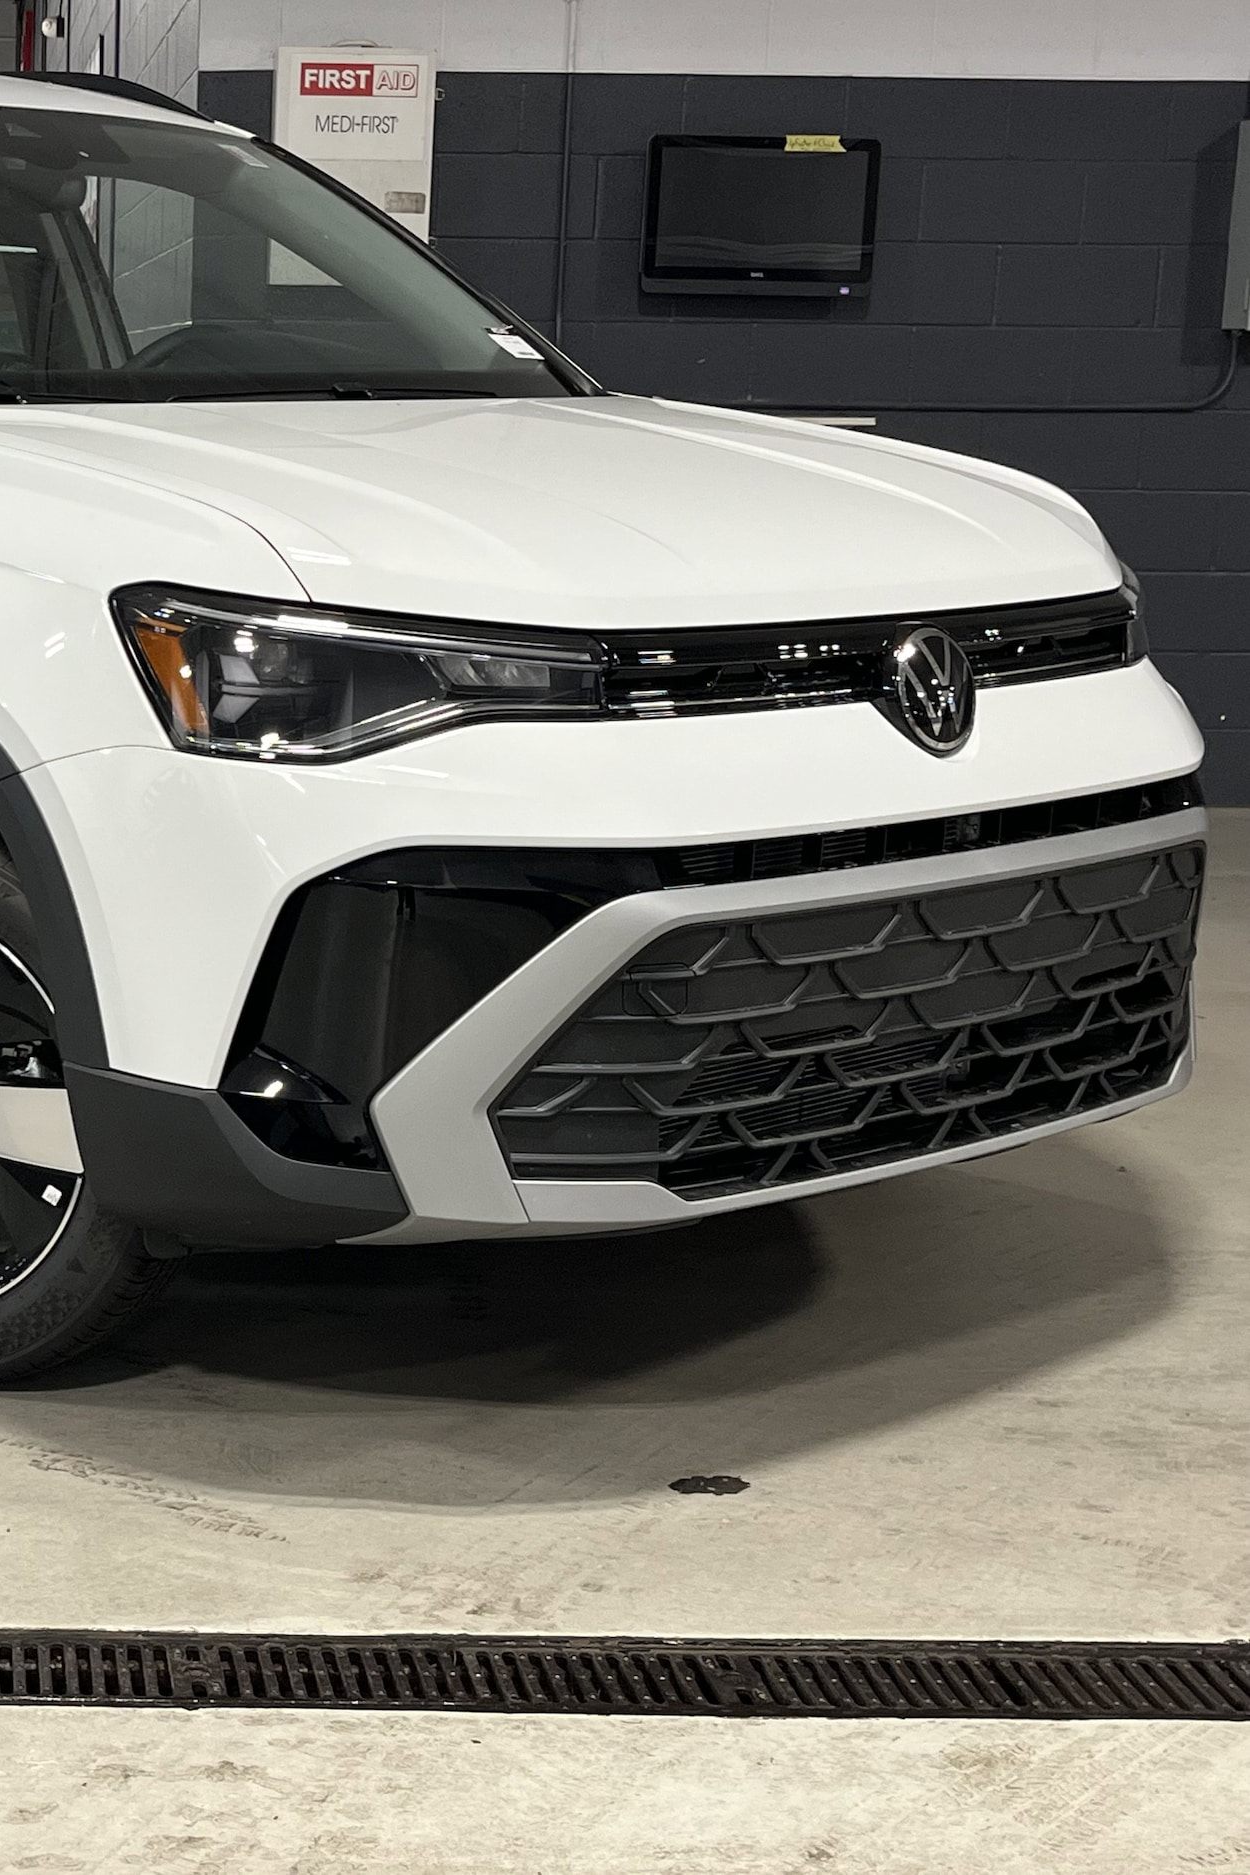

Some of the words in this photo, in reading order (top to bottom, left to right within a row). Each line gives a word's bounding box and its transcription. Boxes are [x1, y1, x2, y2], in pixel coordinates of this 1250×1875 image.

[304, 69, 371, 90] FIRST
[375, 70, 415, 91] AID
[315, 114, 397, 134] MEDI-FIRST
